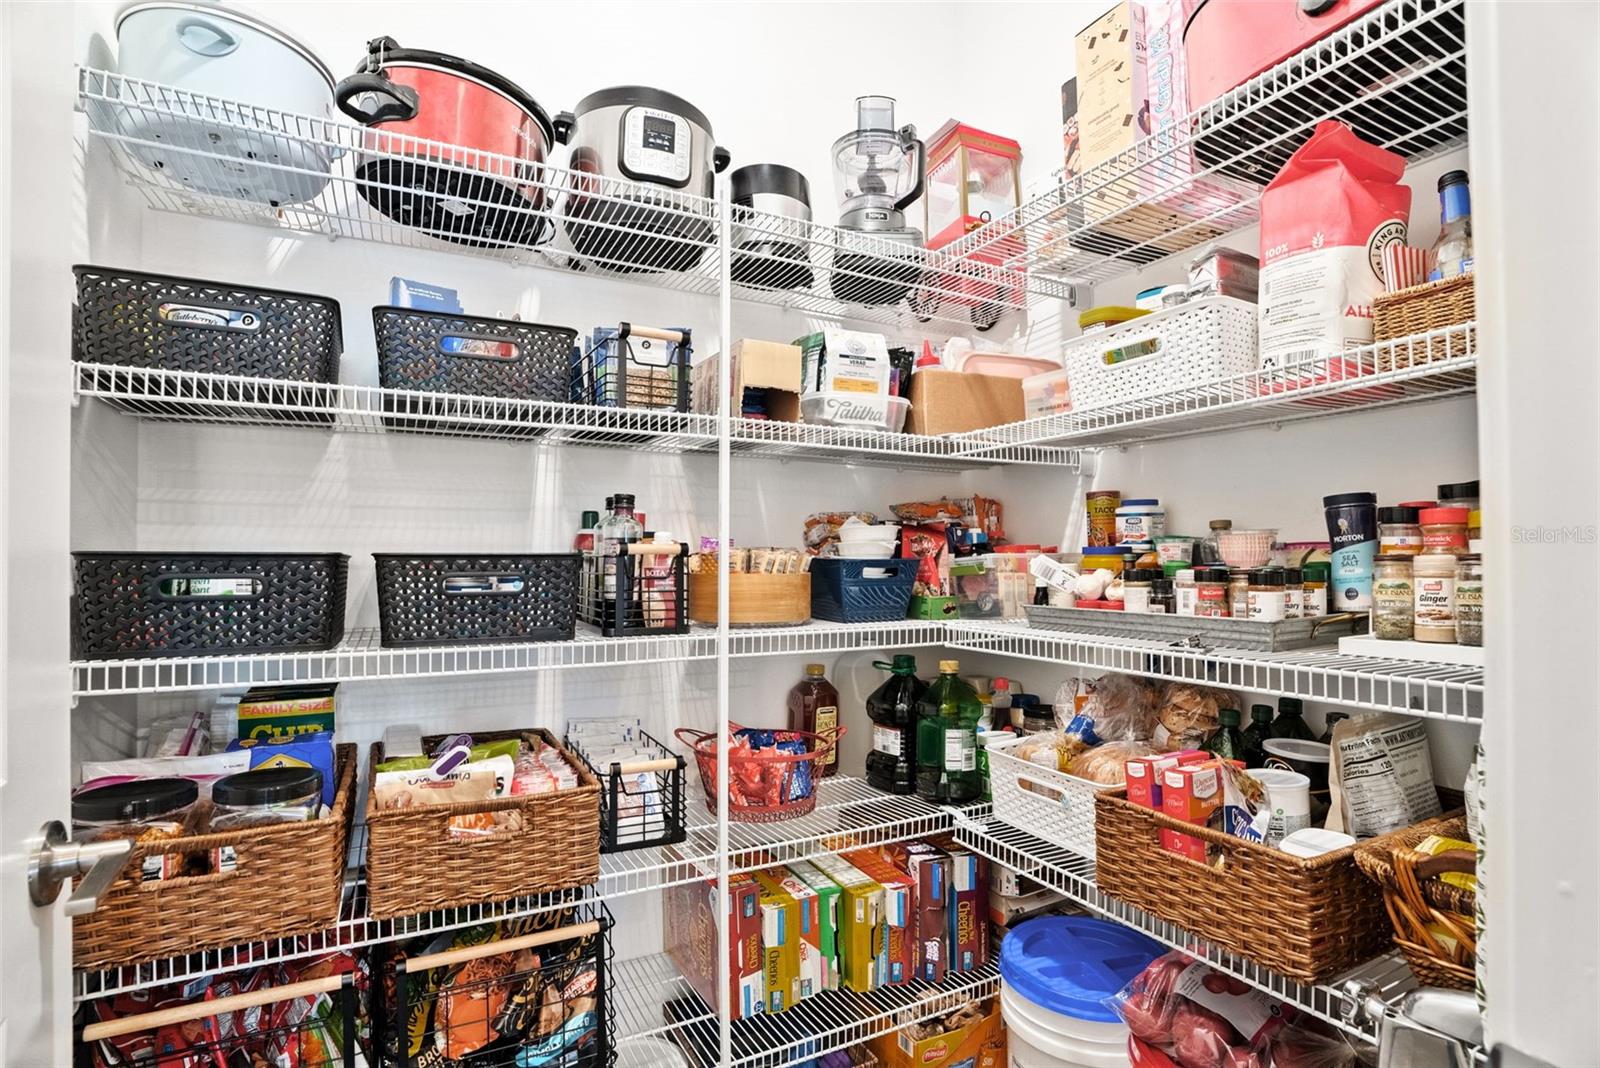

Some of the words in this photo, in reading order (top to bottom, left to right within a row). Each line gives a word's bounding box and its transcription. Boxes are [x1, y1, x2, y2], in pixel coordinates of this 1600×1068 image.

[1375, 228, 1393, 251] KING
[1265, 242, 1288, 259] 100%
[1345, 304, 1373, 318] ALL
[827, 398, 883, 423] Talitha
[1095, 506, 1116, 514] TACO
[1333, 534, 1364, 543] MORTON
[1419, 595, 1448, 604] Ginger
[240, 704, 294, 716] FAMILY
[298, 699, 331, 711] SIZE
[1380, 760, 1392, 769] 120
[1343, 769, 1370, 778] Calories
[958, 901, 969, 945] Cheerios
[769, 950, 780, 986] Cheerios
